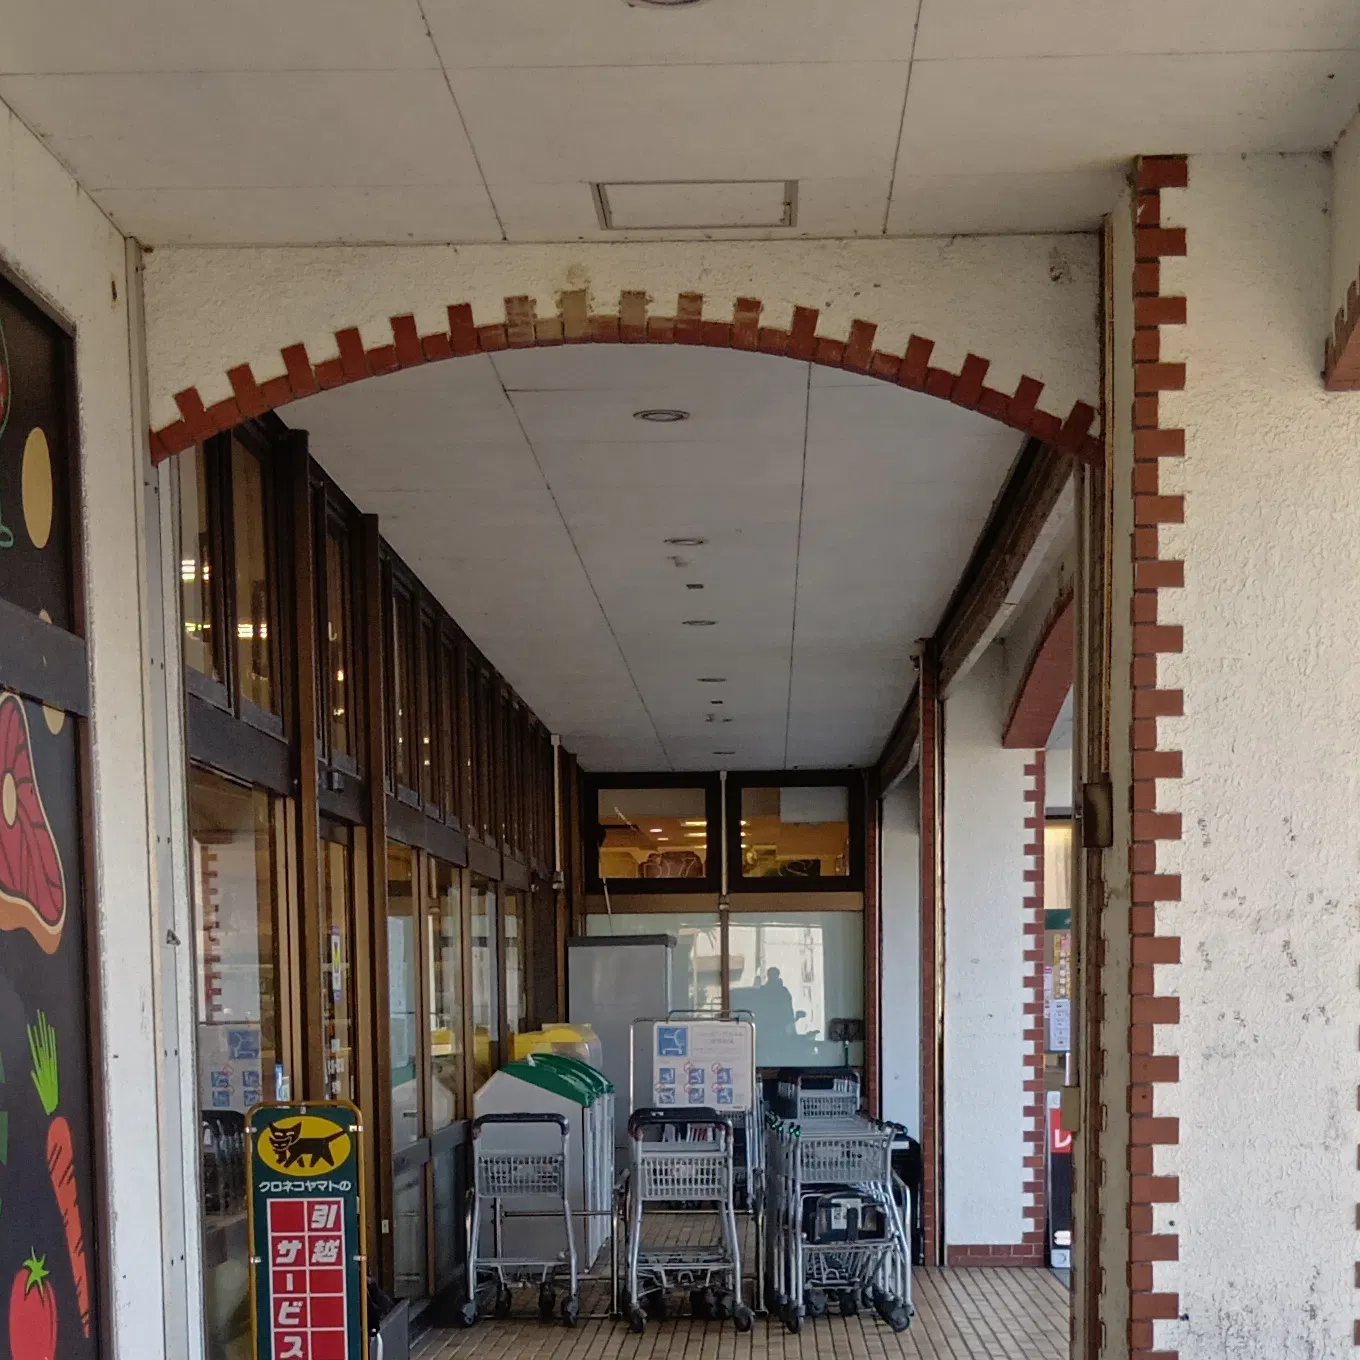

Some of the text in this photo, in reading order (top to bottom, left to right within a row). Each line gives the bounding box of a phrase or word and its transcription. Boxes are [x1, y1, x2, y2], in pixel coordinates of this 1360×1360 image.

[258, 1179, 352, 1193] クロネコヤマトの
[310, 1204, 341, 1264] 引越
[275, 1239, 305, 1360] サービス
